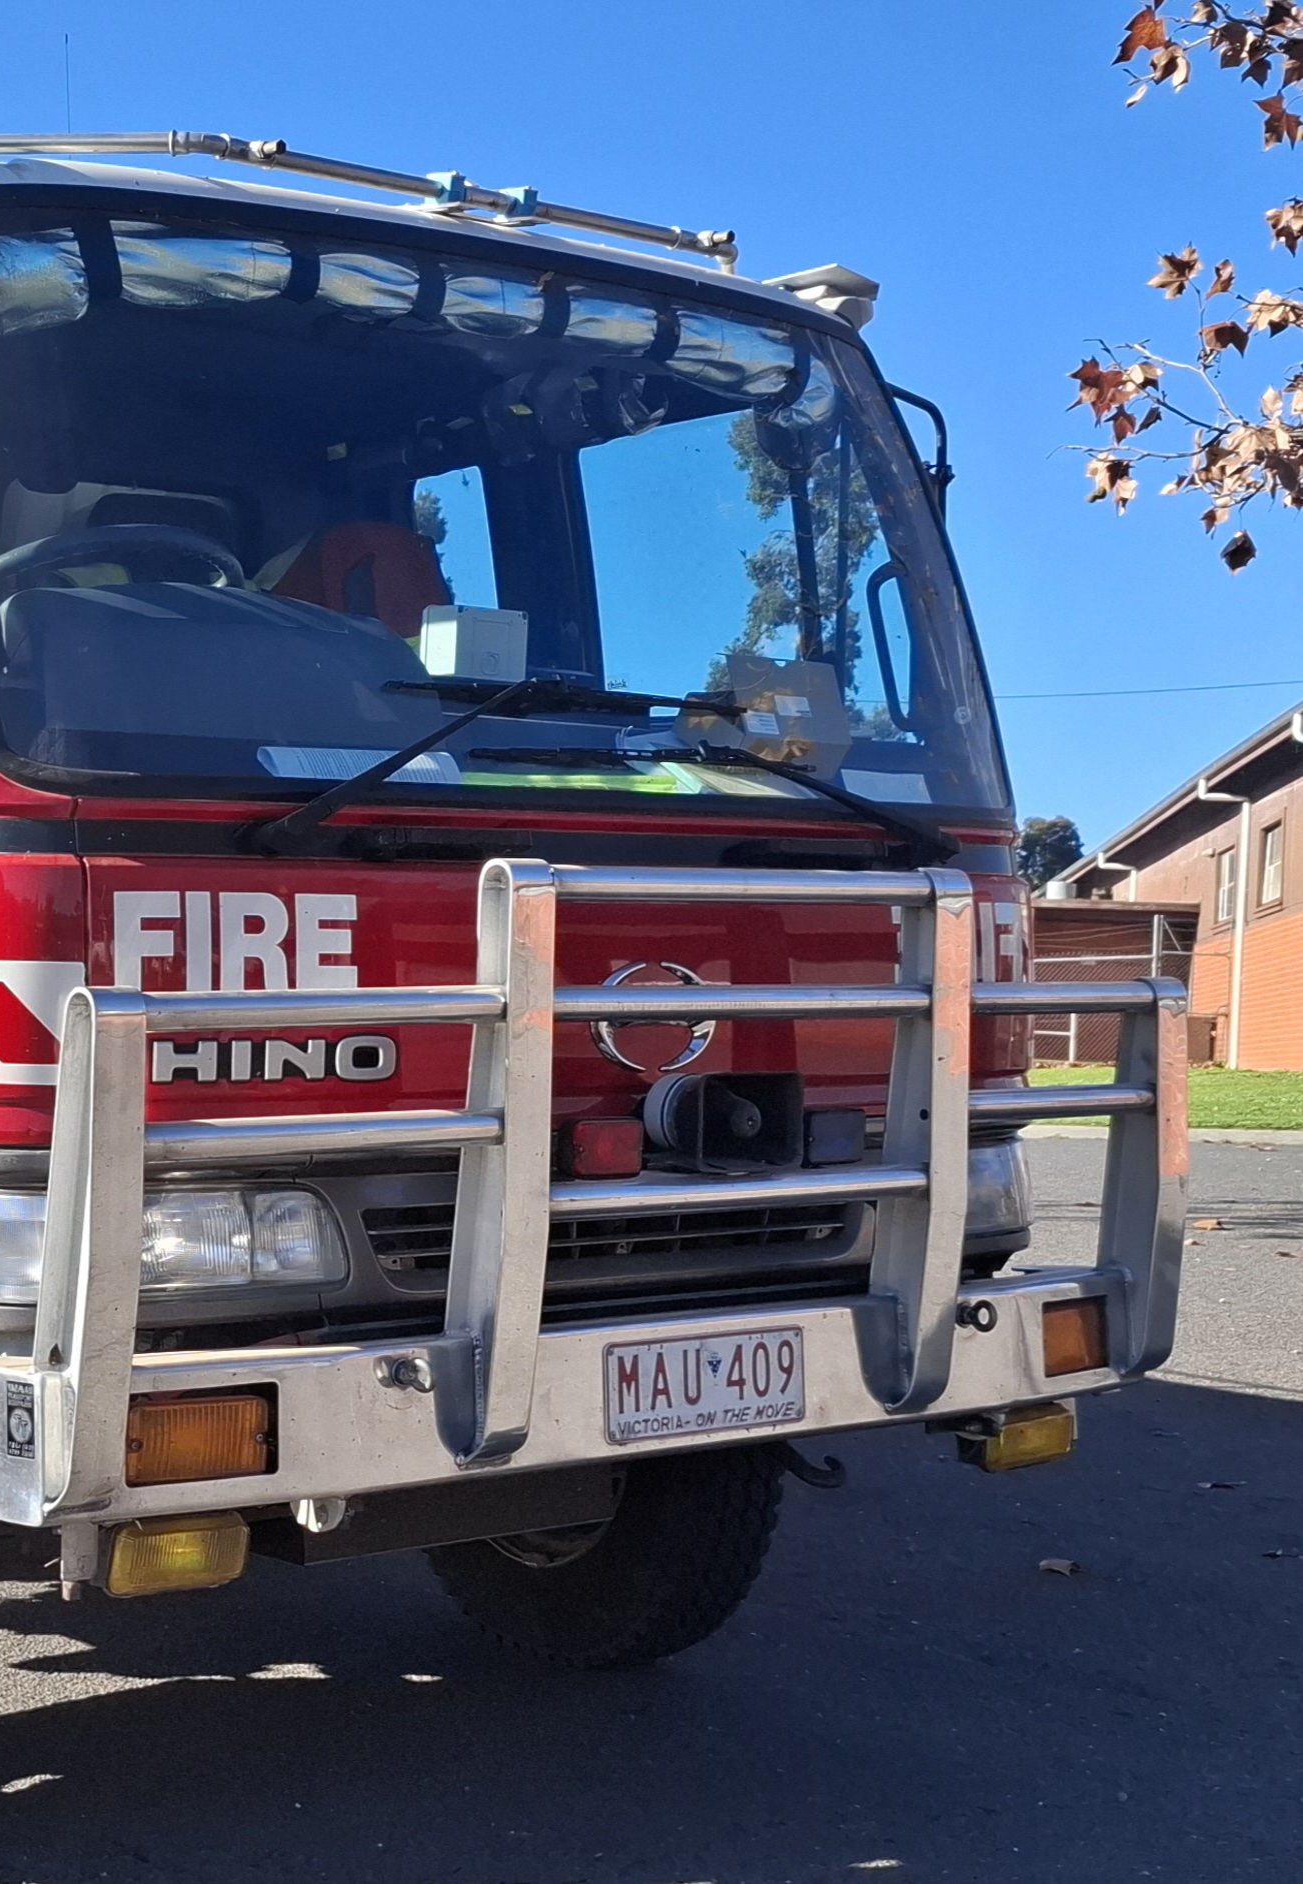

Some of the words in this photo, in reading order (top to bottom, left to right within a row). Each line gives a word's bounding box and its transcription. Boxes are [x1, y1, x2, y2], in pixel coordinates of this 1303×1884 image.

[113, 891, 358, 991] FIRE
[152, 1035, 397, 1083] HINO
[617, 1348, 702, 1414] MAU
[726, 1339, 794, 1401] 409
[696, 1410, 717, 1426] ON
[723, 1405, 751, 1422] THE
[753, 1401, 795, 1420] MOVE
